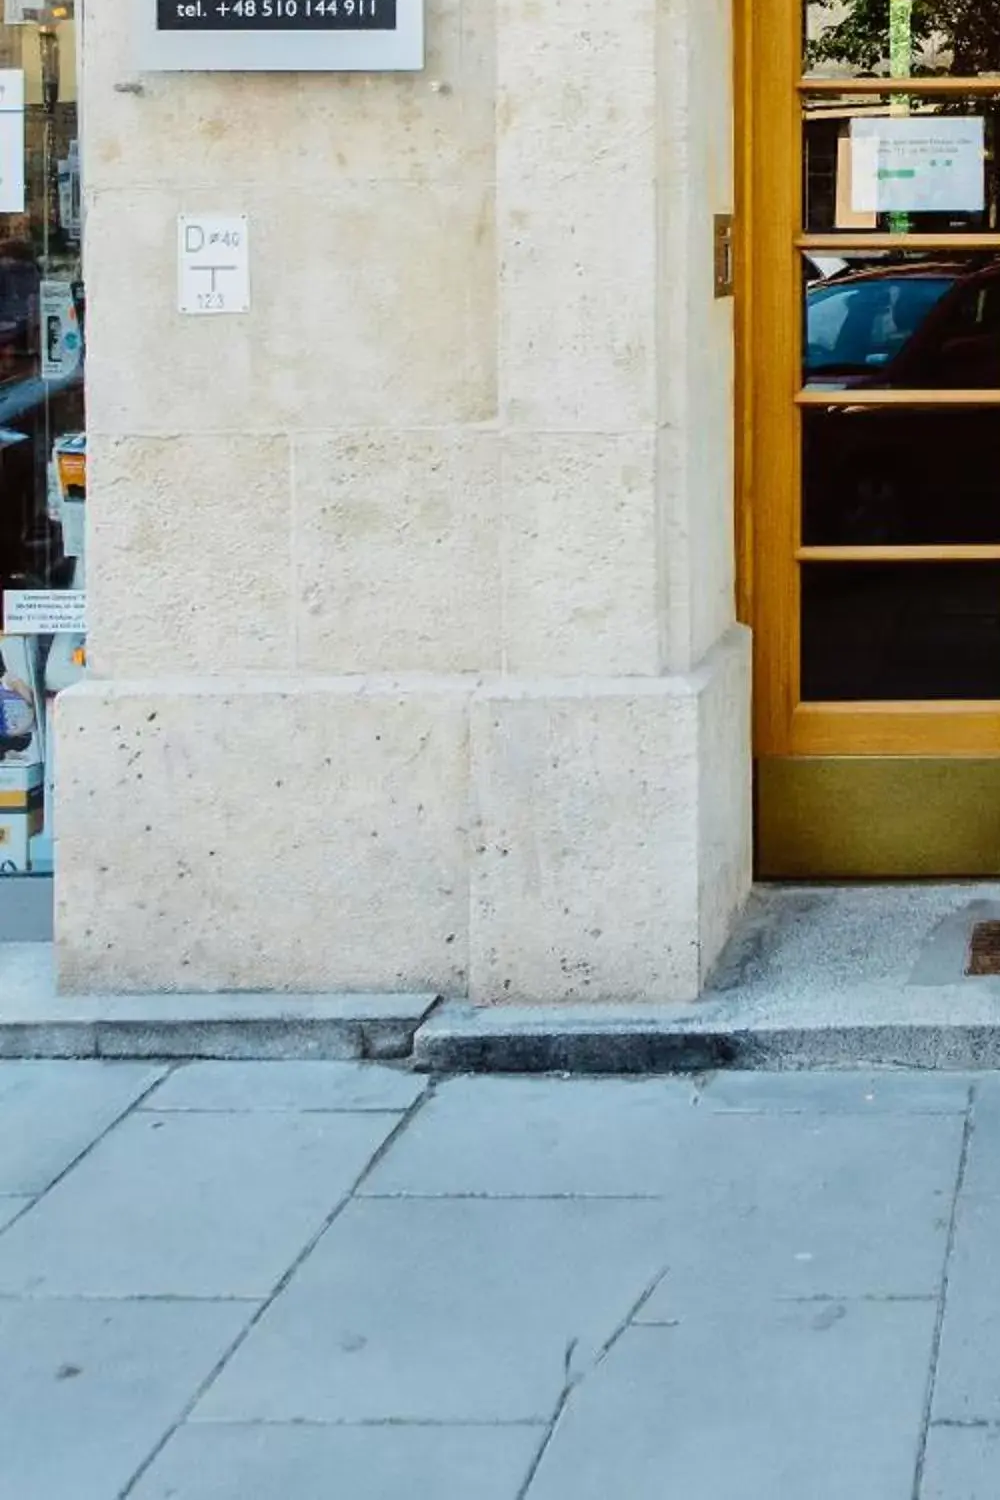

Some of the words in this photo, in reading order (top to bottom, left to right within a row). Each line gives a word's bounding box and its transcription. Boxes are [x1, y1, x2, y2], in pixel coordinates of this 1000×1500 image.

[176, 0, 208, 18] tel.
[215, 0, 257, 17] +48
[261, 0, 298, 17] 510
[305, 0, 338, 17] 144
[343, 0, 377, 17] 911
